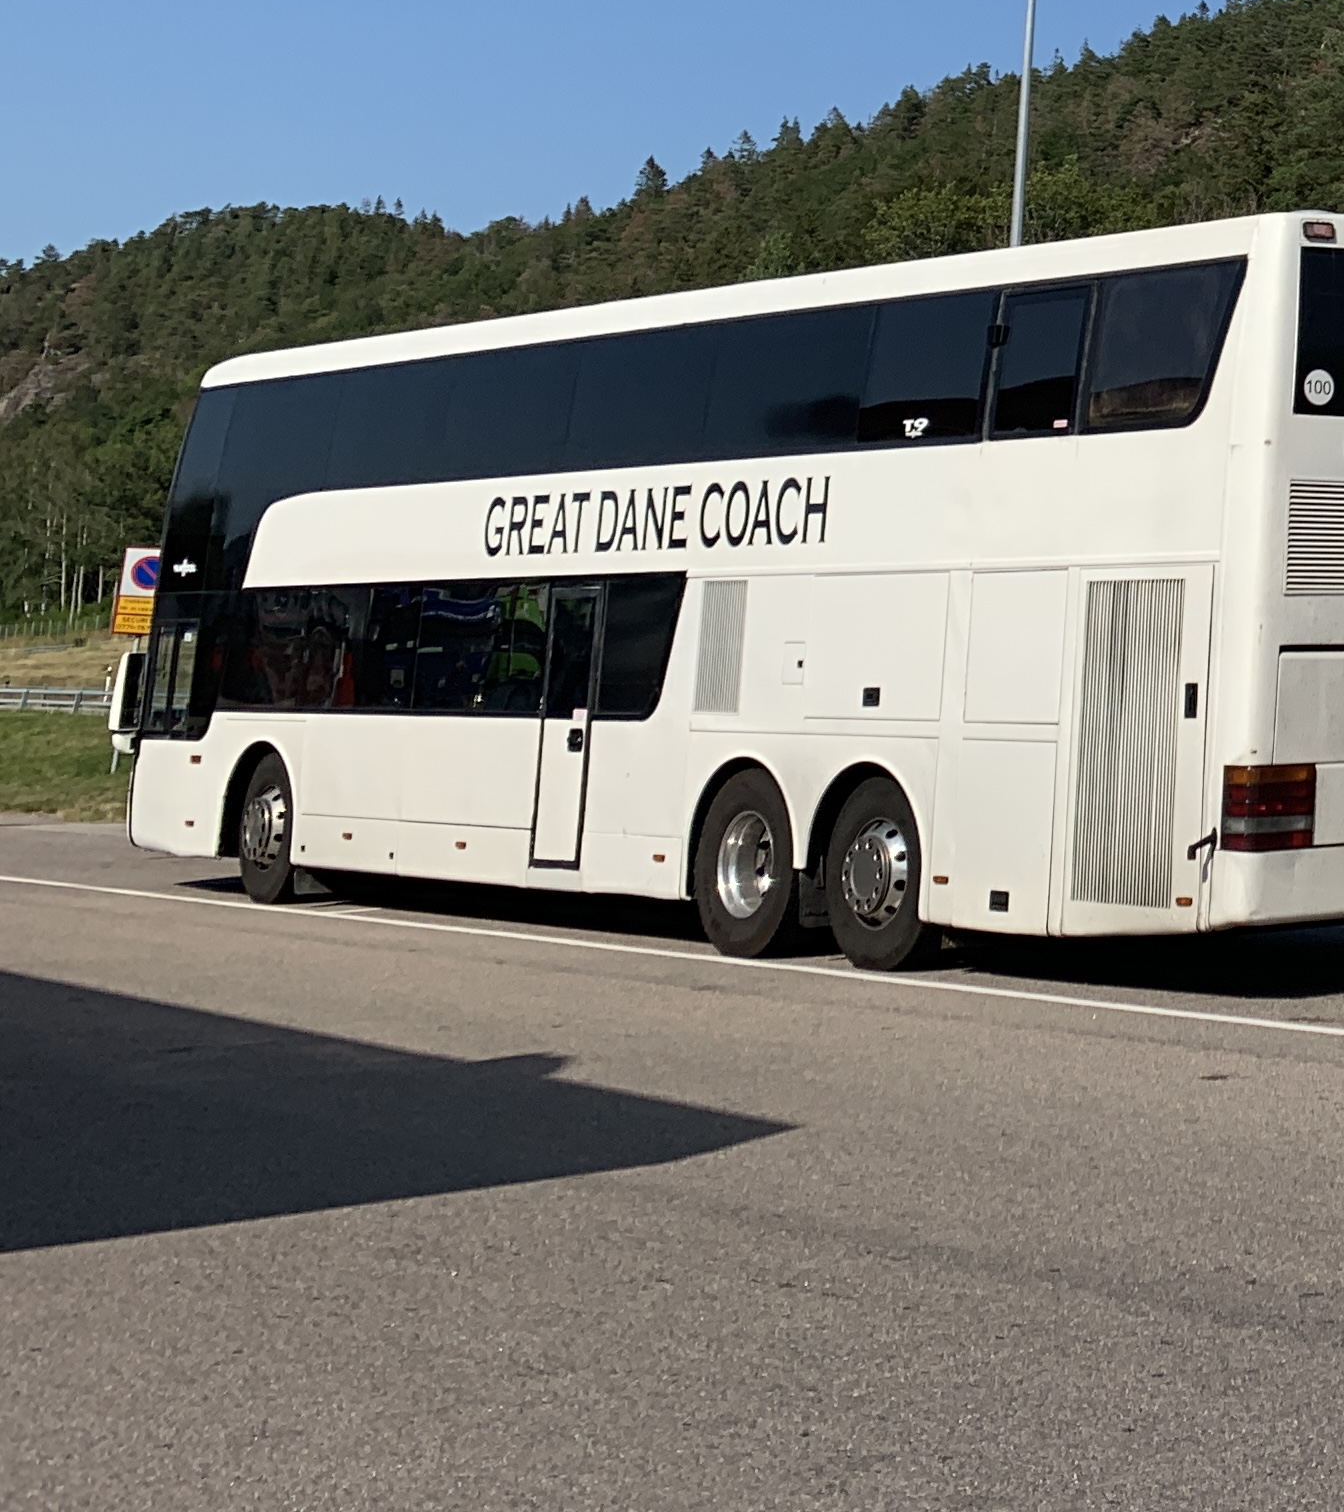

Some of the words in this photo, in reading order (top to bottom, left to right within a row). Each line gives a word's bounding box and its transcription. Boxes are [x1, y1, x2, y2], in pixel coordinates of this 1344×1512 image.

[1306, 379, 1331, 396] 100
[484, 489, 592, 557] GREAT
[594, 482, 693, 553] DANE
[700, 475, 832, 548] COACH
